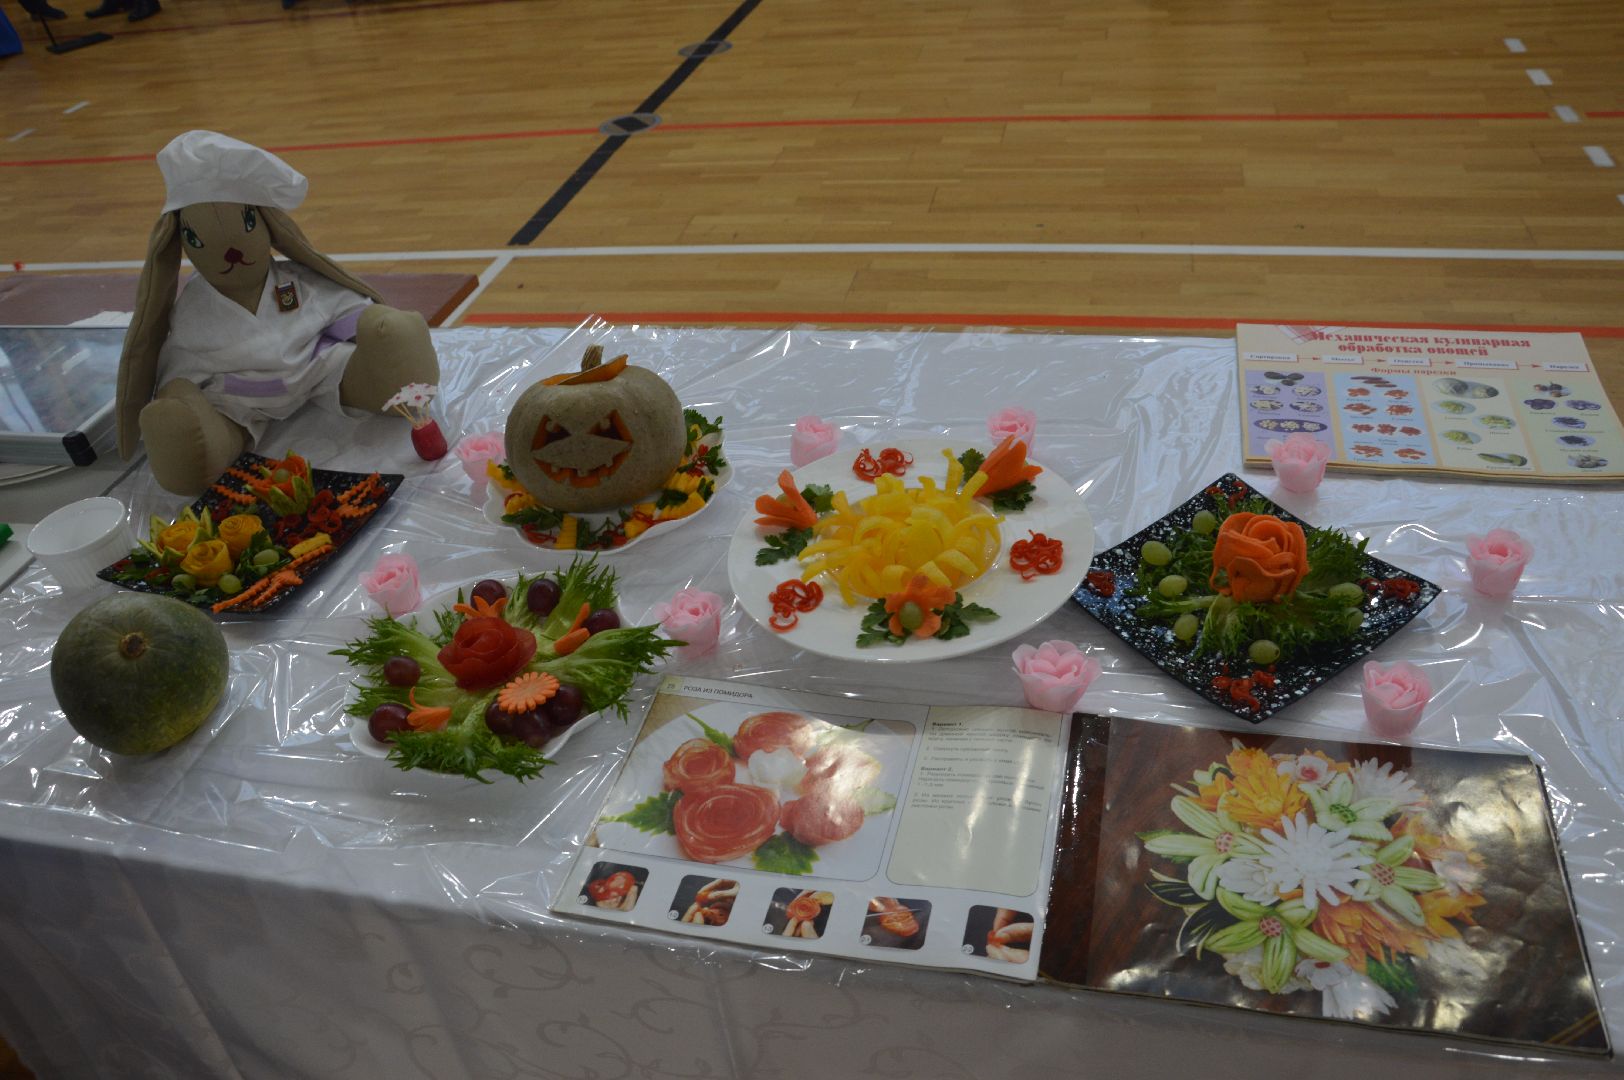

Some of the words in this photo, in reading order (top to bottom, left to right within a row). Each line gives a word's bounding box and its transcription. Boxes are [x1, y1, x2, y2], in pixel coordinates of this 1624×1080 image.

[1311, 330, 1429, 344] Механическая
[1434, 336, 1531, 348] кулинарная
[1338, 342, 1423, 354] обработка
[1427, 346, 1489, 357] овощей
[683, 685, 702, 693] РОЗА
